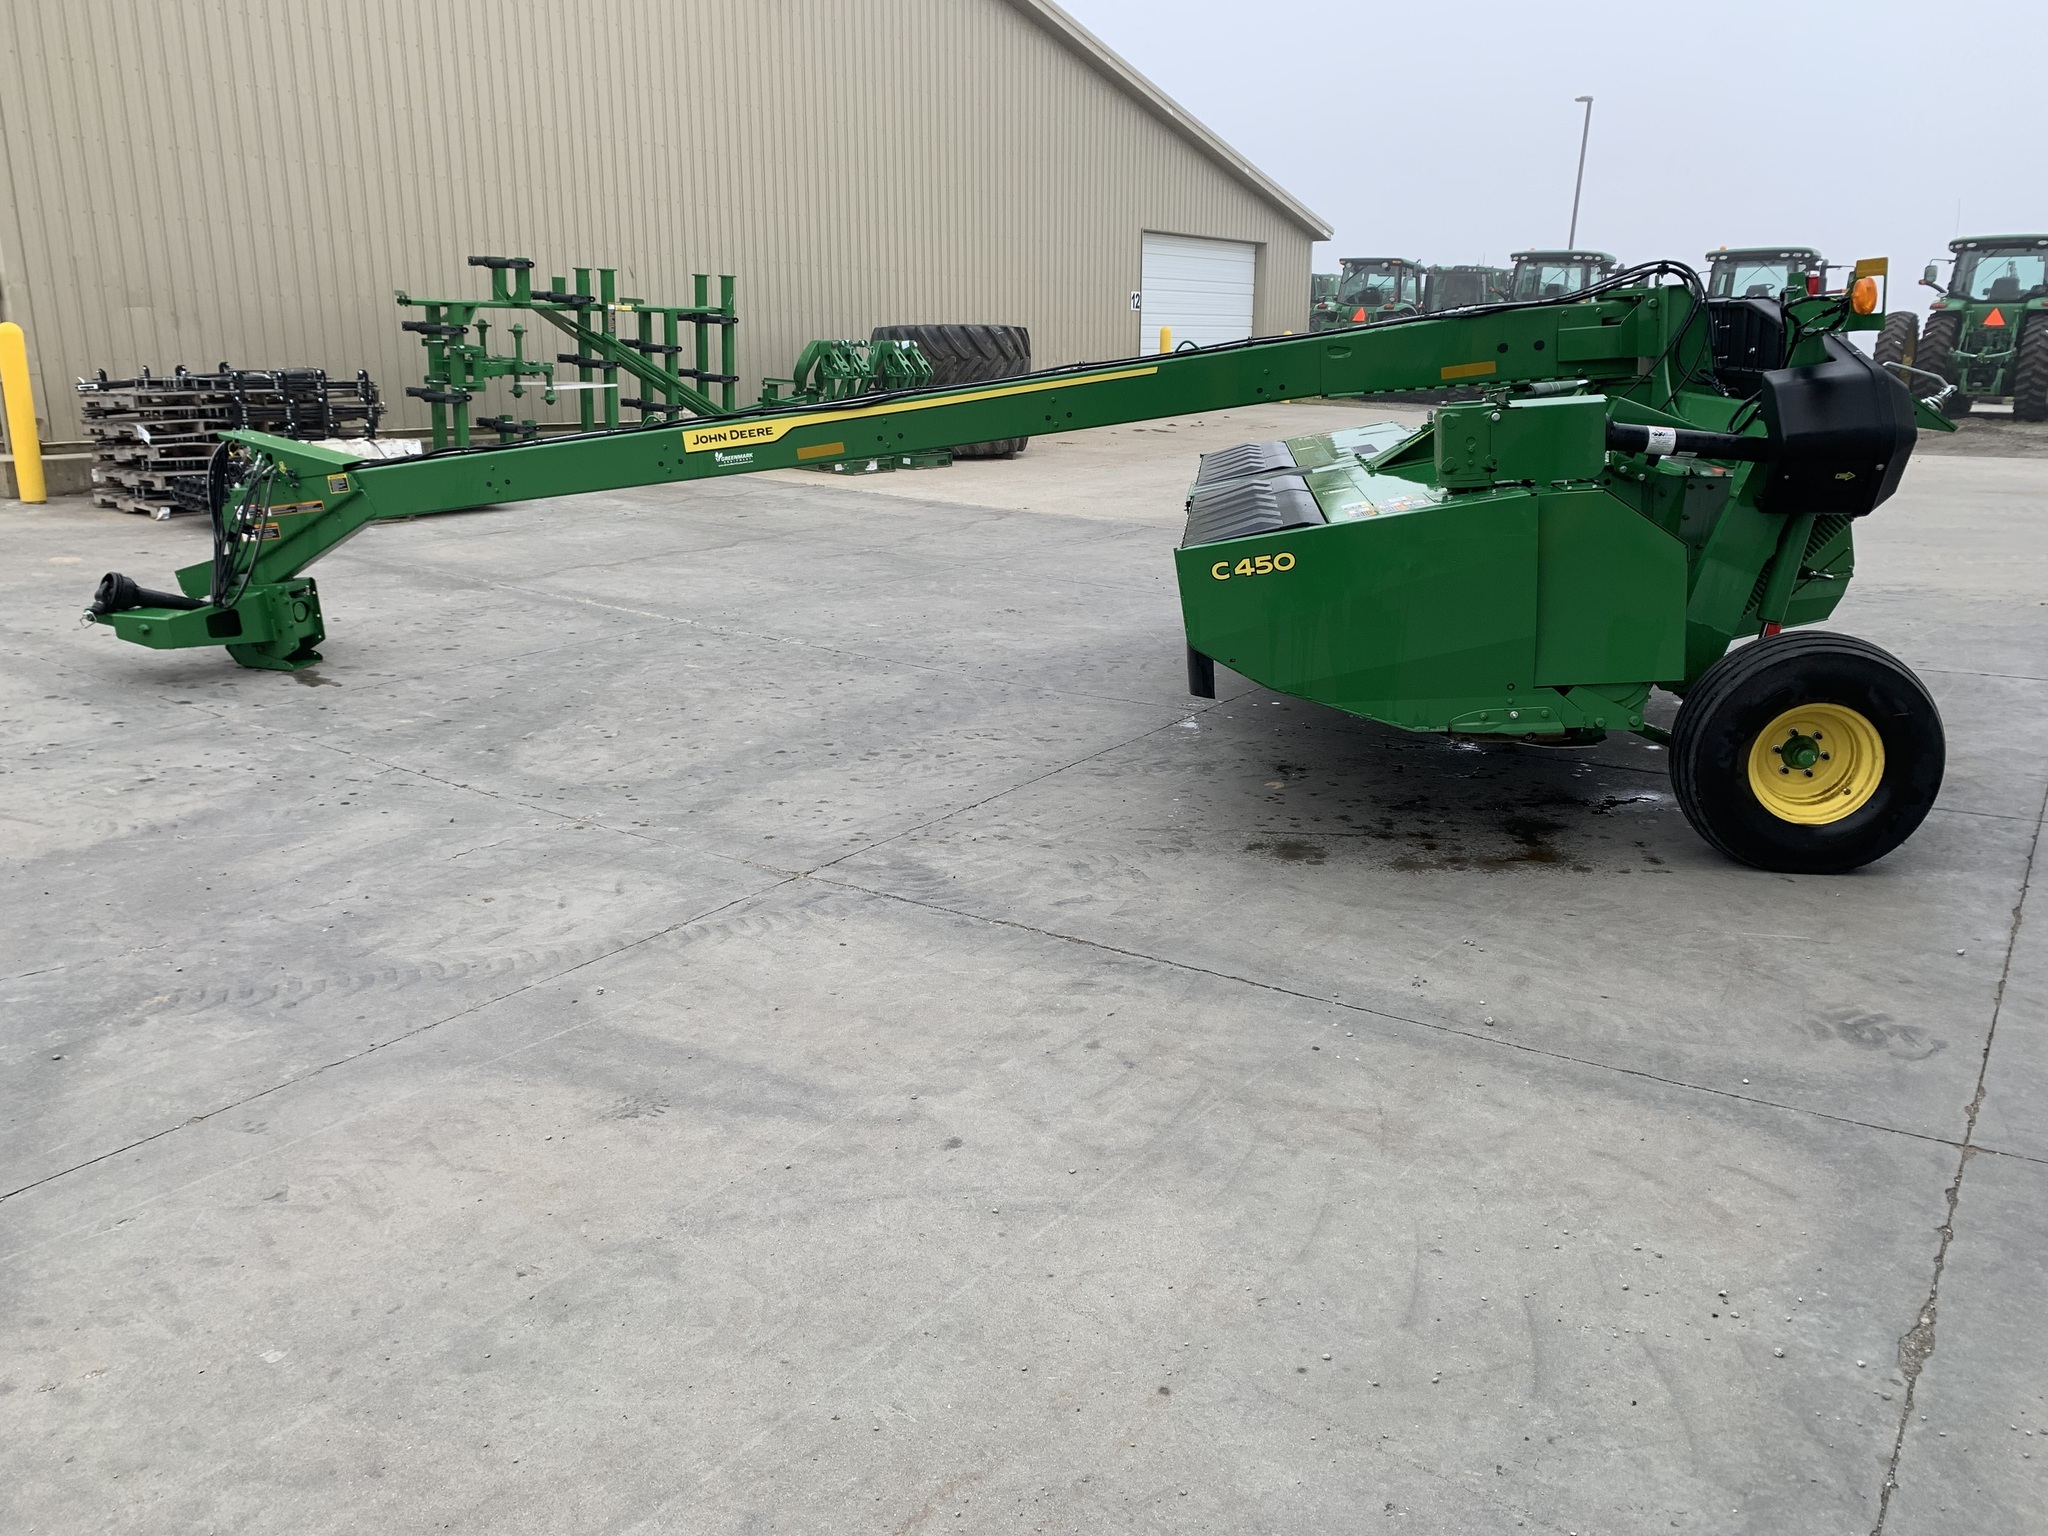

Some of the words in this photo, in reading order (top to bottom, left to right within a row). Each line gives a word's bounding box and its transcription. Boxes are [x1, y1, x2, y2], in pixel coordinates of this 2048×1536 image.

[1131, 292, 1140, 309] 12
[693, 432, 727, 445] JOHN
[729, 426, 774, 440] DEERE
